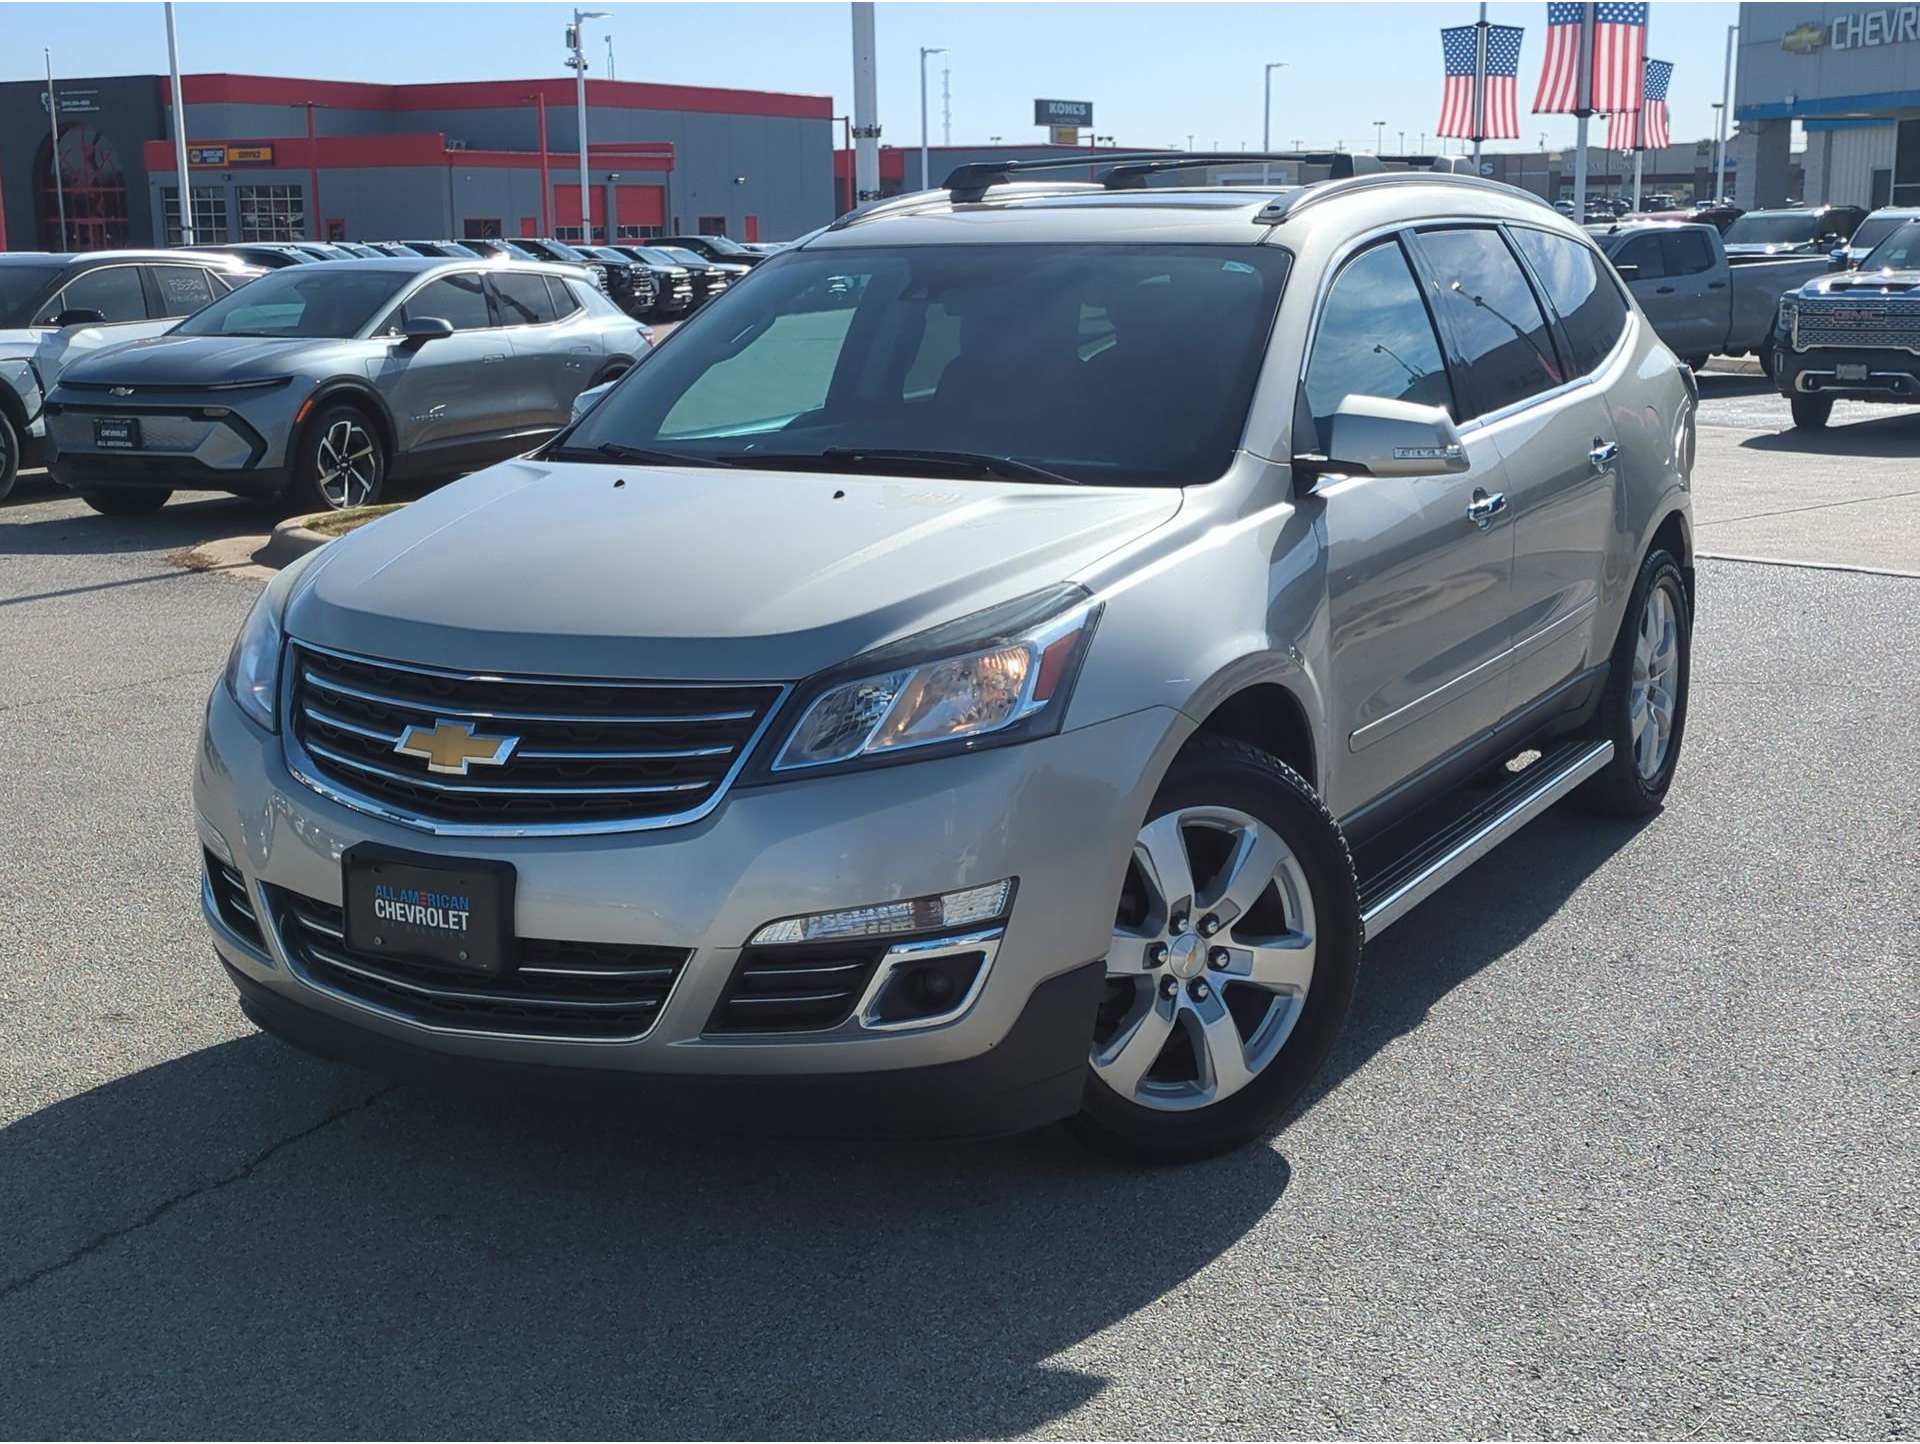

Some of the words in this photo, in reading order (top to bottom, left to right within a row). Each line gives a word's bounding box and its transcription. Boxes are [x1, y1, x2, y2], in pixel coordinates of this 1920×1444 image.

[1831, 5, 1920, 50] CHEVR
[1833, 308, 1886, 321] GMC
[375, 884, 397, 901] ALL
[400, 888, 470, 911] AMERICAN
[374, 898, 470, 931] CHEVROLET
